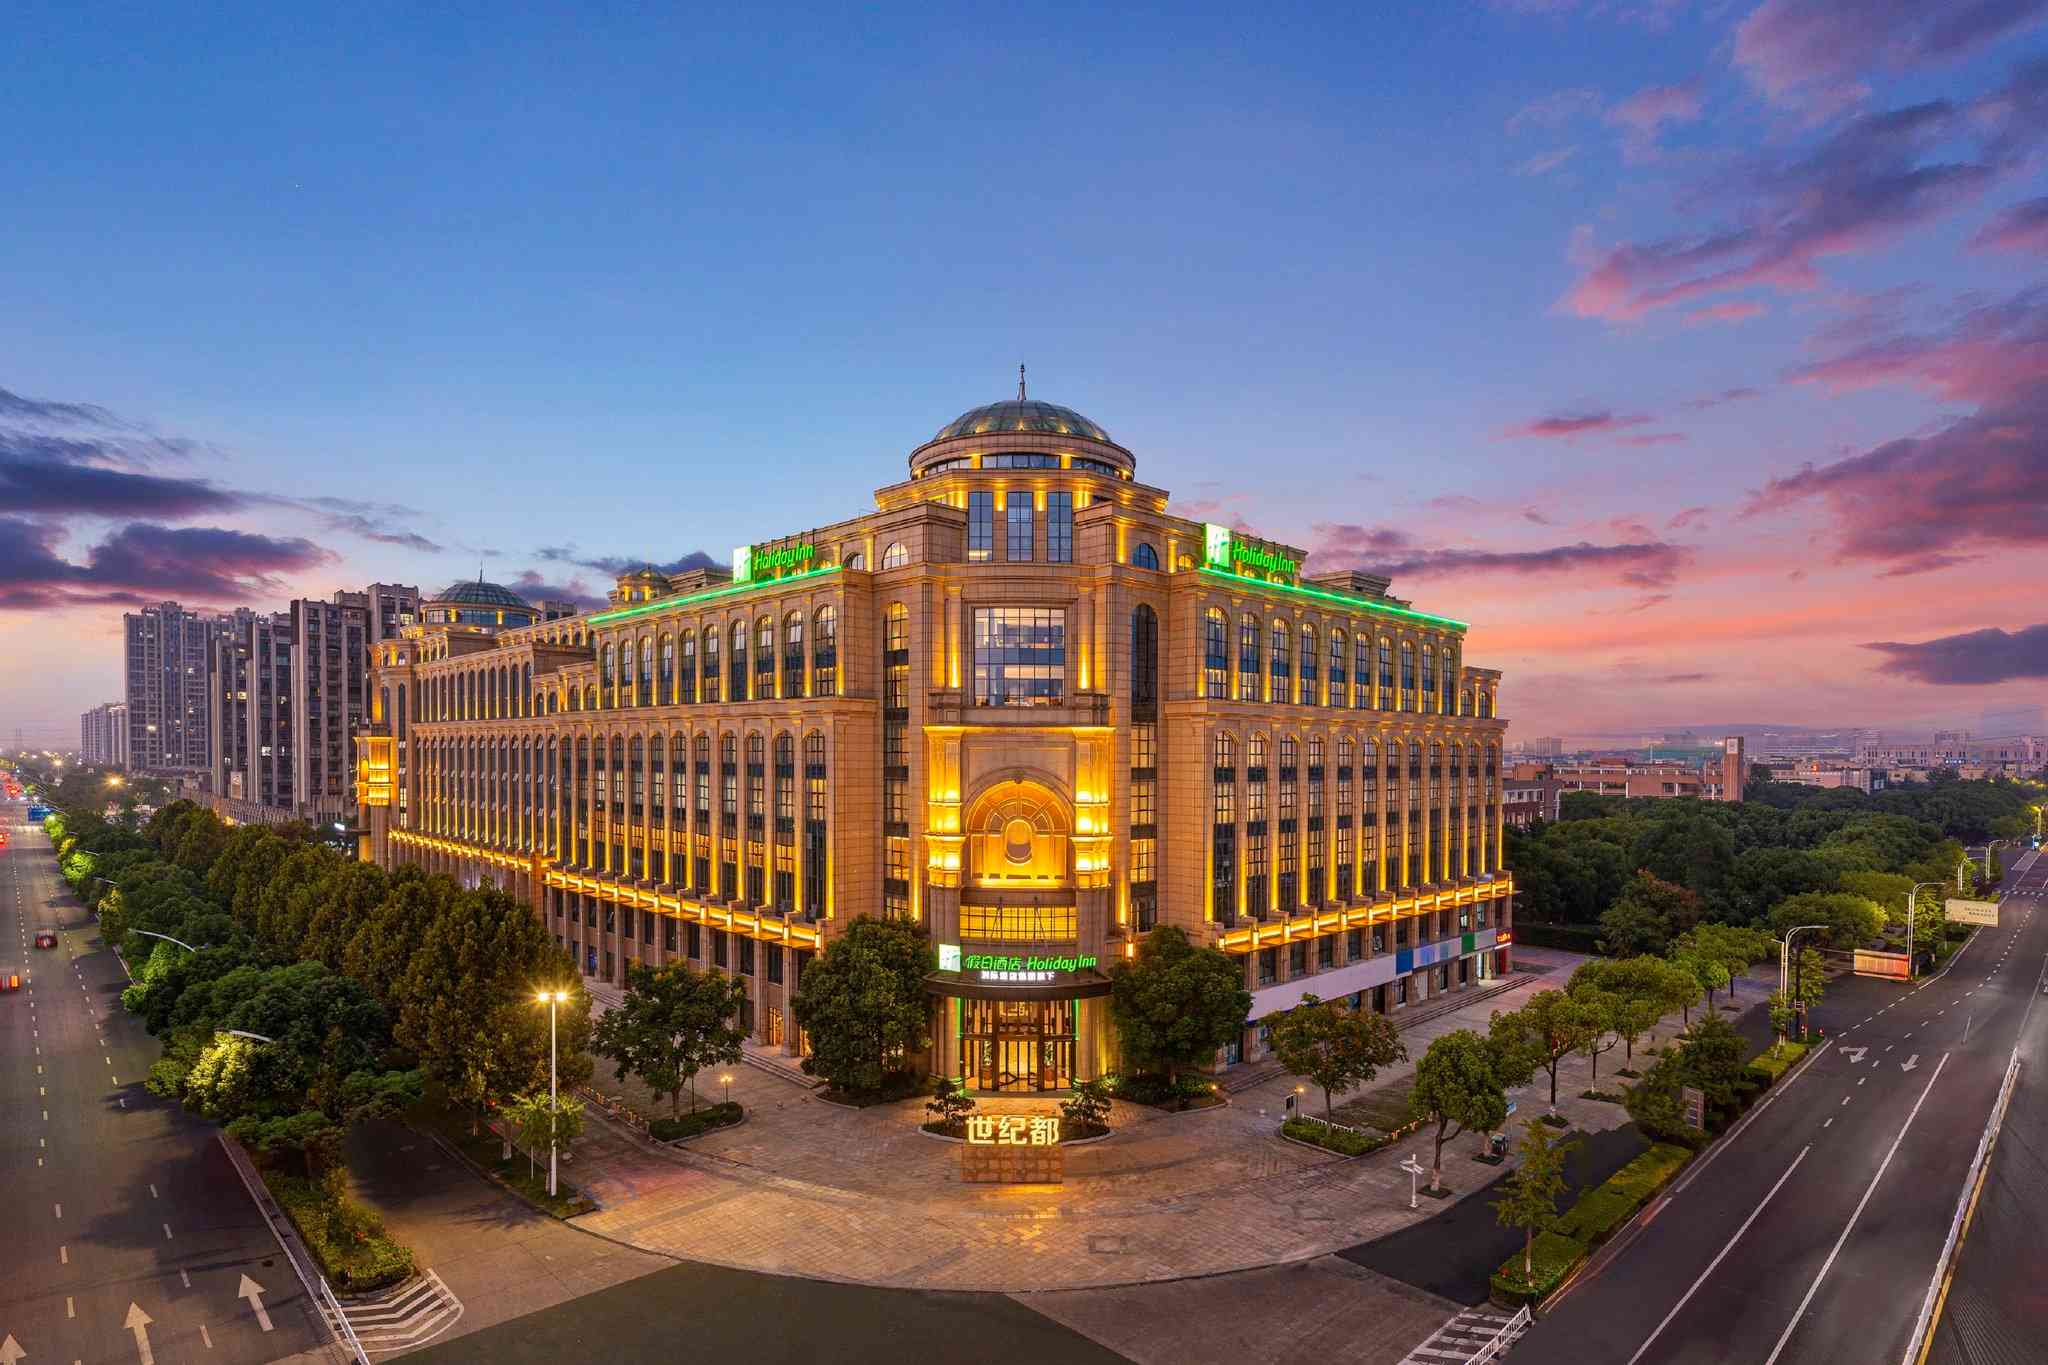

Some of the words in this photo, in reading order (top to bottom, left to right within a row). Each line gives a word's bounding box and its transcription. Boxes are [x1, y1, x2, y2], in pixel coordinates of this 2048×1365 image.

[755, 546, 795, 570] Holiday
[796, 541, 814, 561] Inn
[1233, 541, 1277, 573] Holiday
[1279, 552, 1295, 573] Inn
[966, 955, 1022, 970] 假日酒店
[1027, 955, 1077, 971] Holiday
[1078, 954, 1096, 967] Inn
[966, 1115, 1060, 1145] 世纪都
